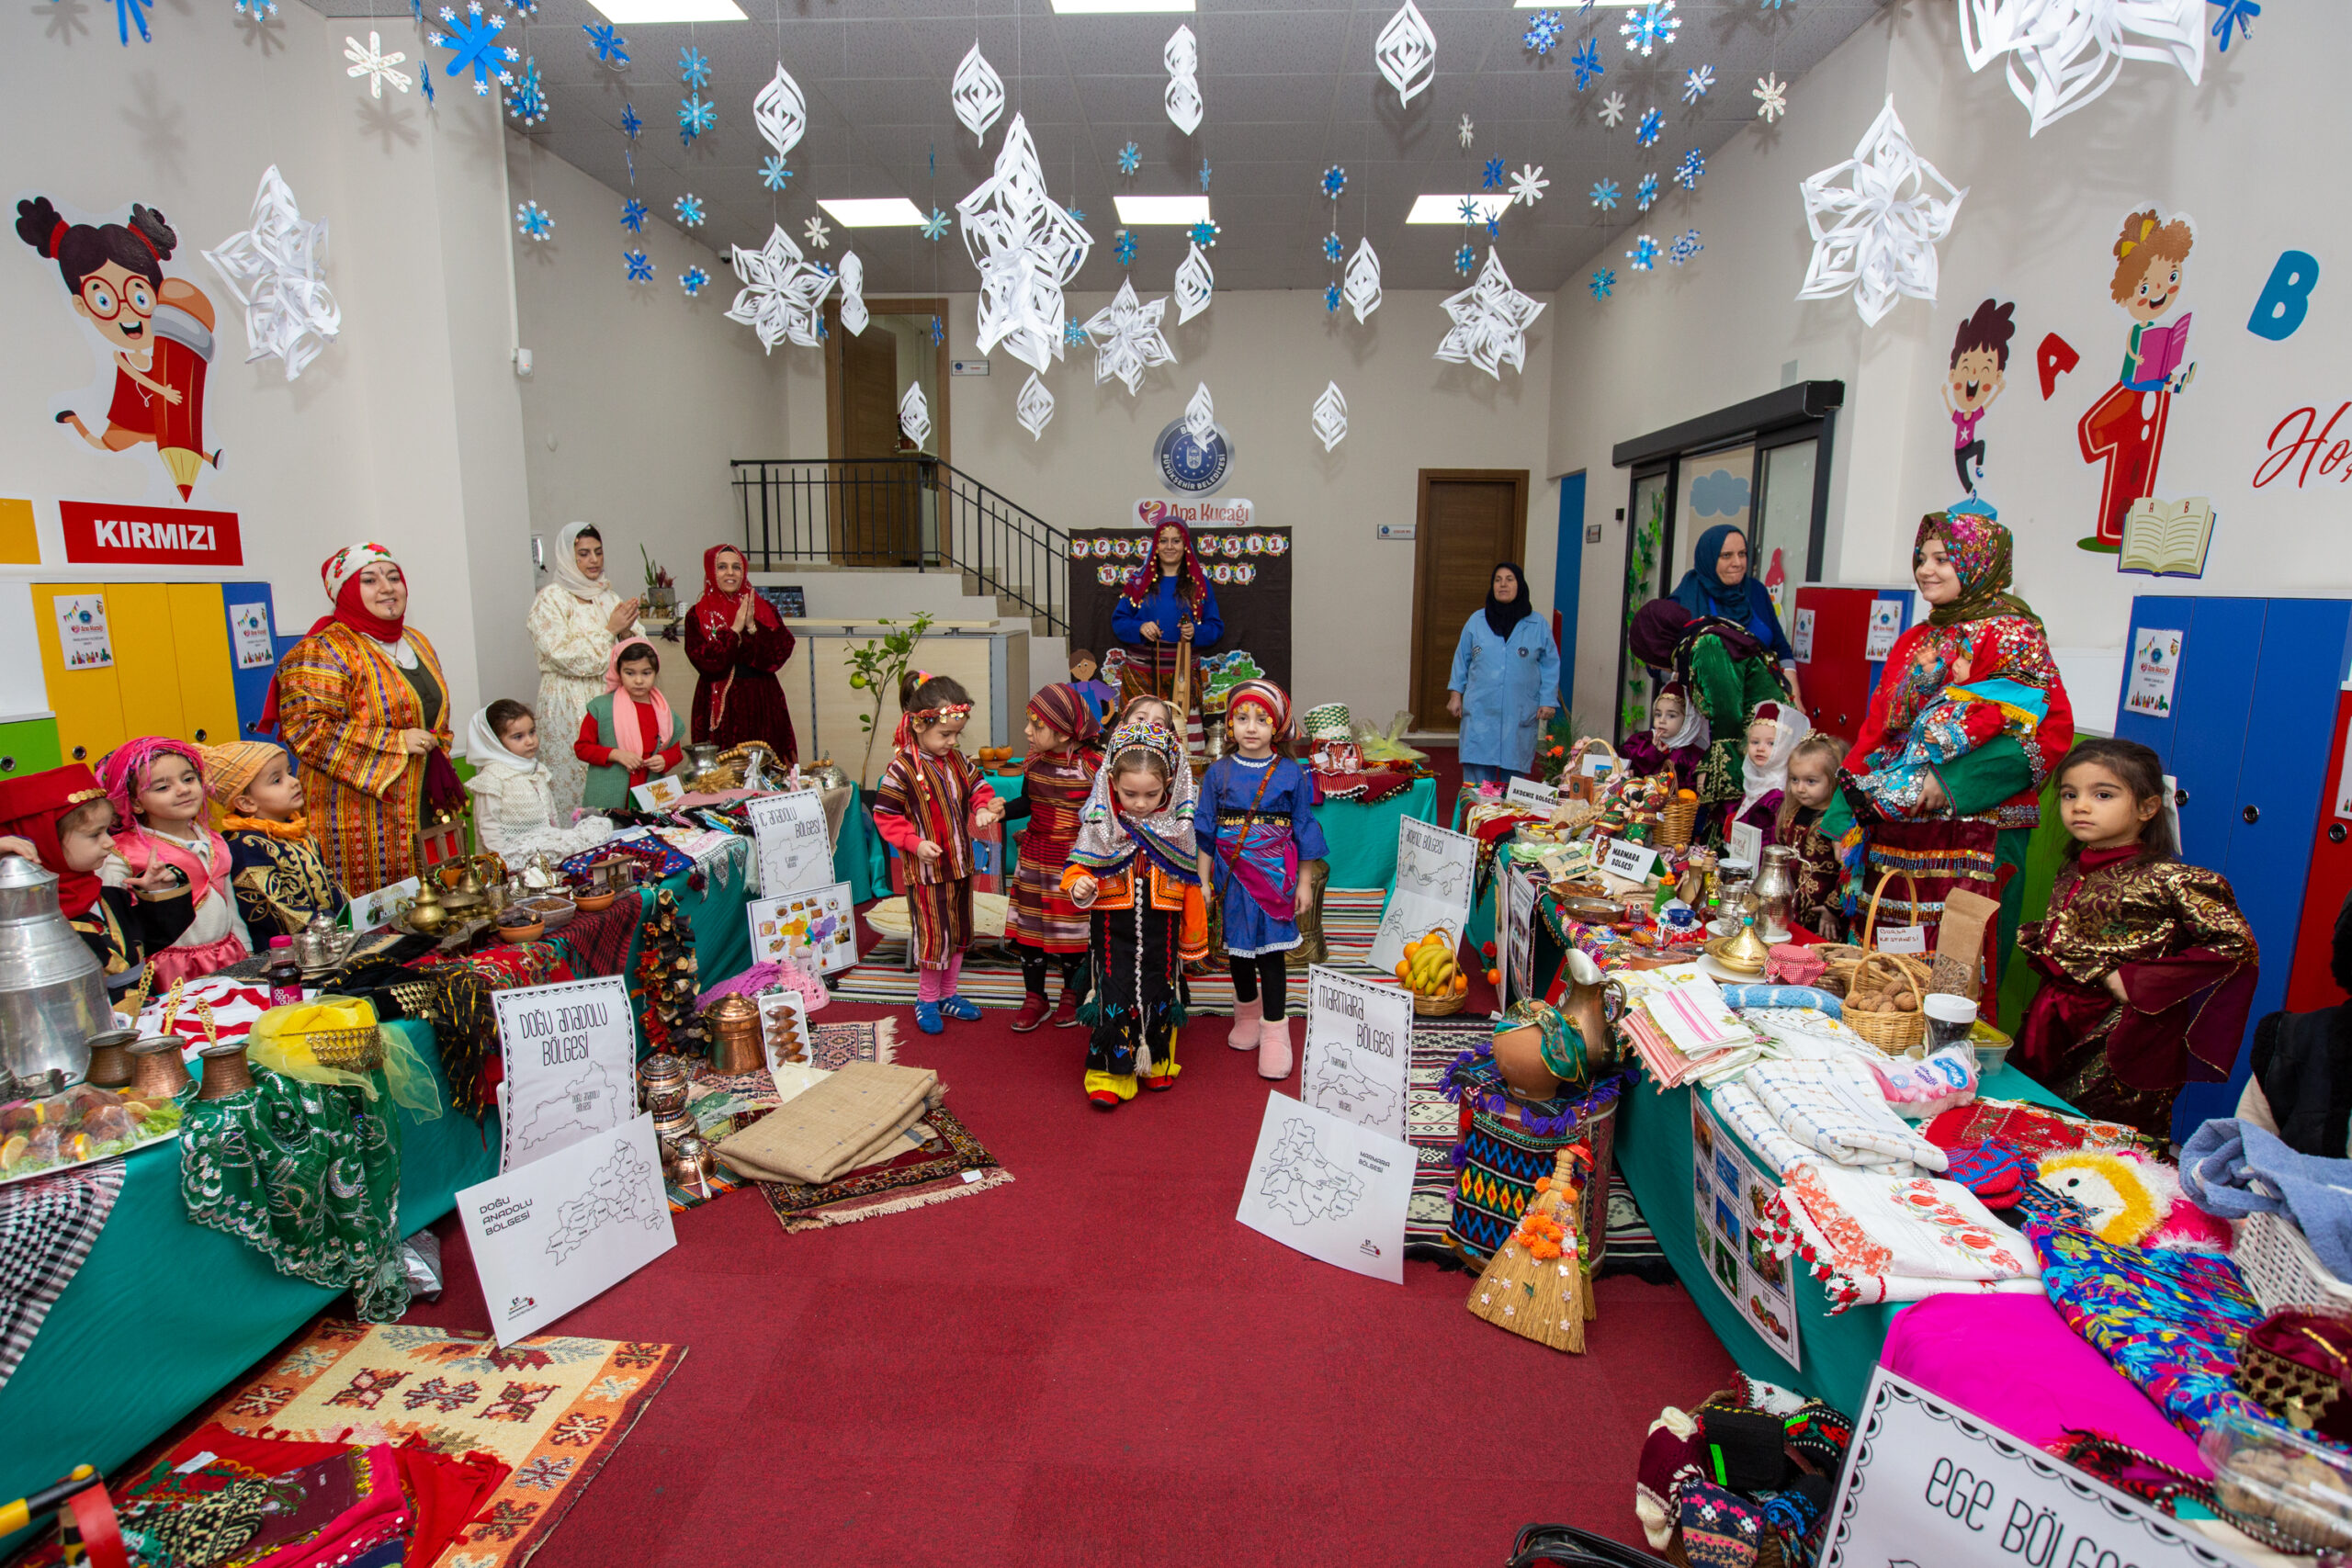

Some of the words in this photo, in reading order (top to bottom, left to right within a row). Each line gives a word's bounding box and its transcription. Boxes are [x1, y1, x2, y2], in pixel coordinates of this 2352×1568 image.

[2247, 250, 2320, 342] B
[2036, 332, 2080, 401] A
[2253, 400, 2352, 489] Ho
[1200, 502, 1250, 526] Kucağı
[94, 519, 217, 551] KIRMIZI
[1611, 847, 1640, 863] MARMARA
[519, 1008, 554, 1039] DOĞU
[1359, 1151, 1391, 1168] MARMARA
[479, 1196, 511, 1214] DOĞU
[482, 1198, 533, 1225] ANADOLU
[485, 1209, 531, 1236] BÖLGESİ
